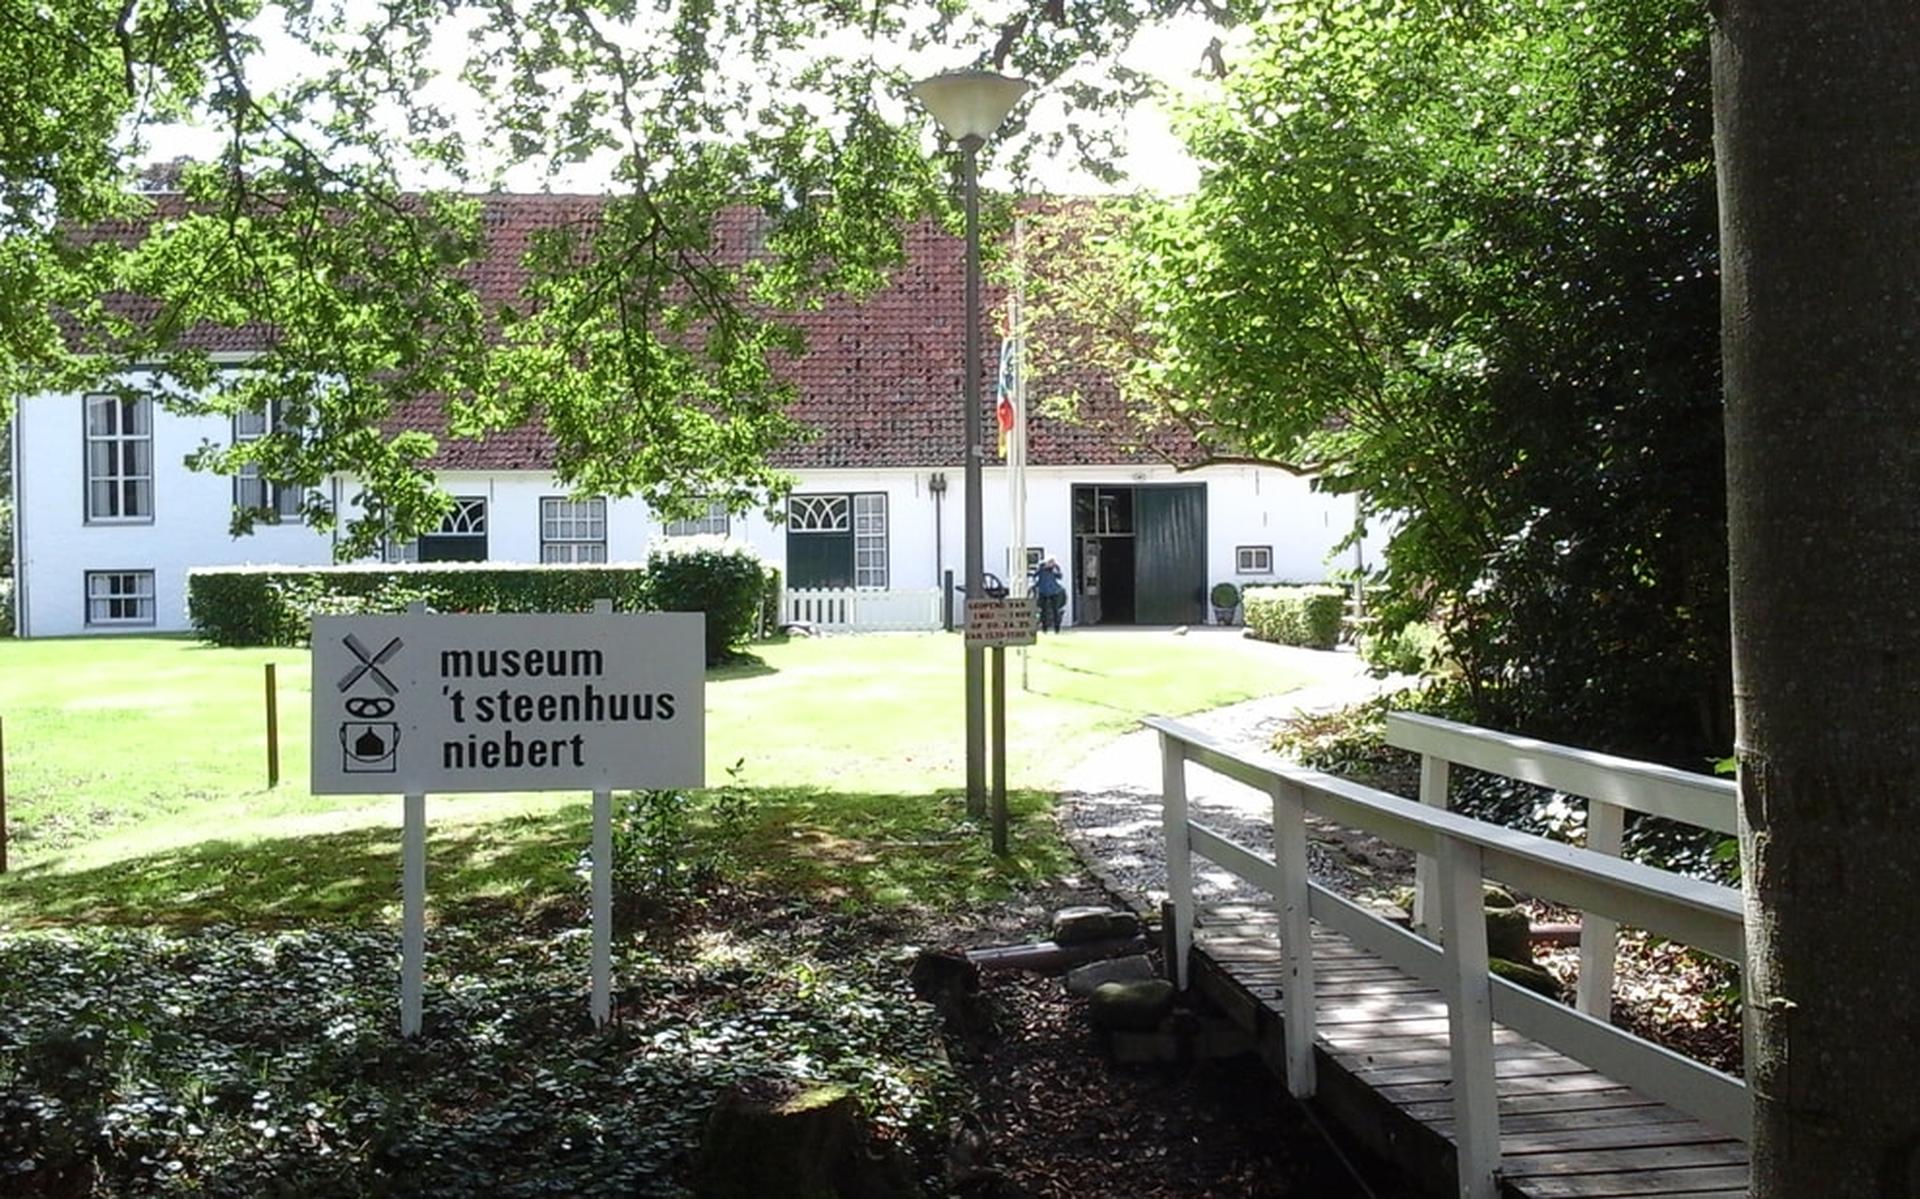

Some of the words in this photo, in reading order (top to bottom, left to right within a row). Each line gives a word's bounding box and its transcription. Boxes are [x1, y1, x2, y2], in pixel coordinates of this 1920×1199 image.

[440, 648, 604, 679] museum
[441, 683, 467, 724] 't
[474, 683, 676, 724] steenhuus
[442, 728, 586, 770] niebert
